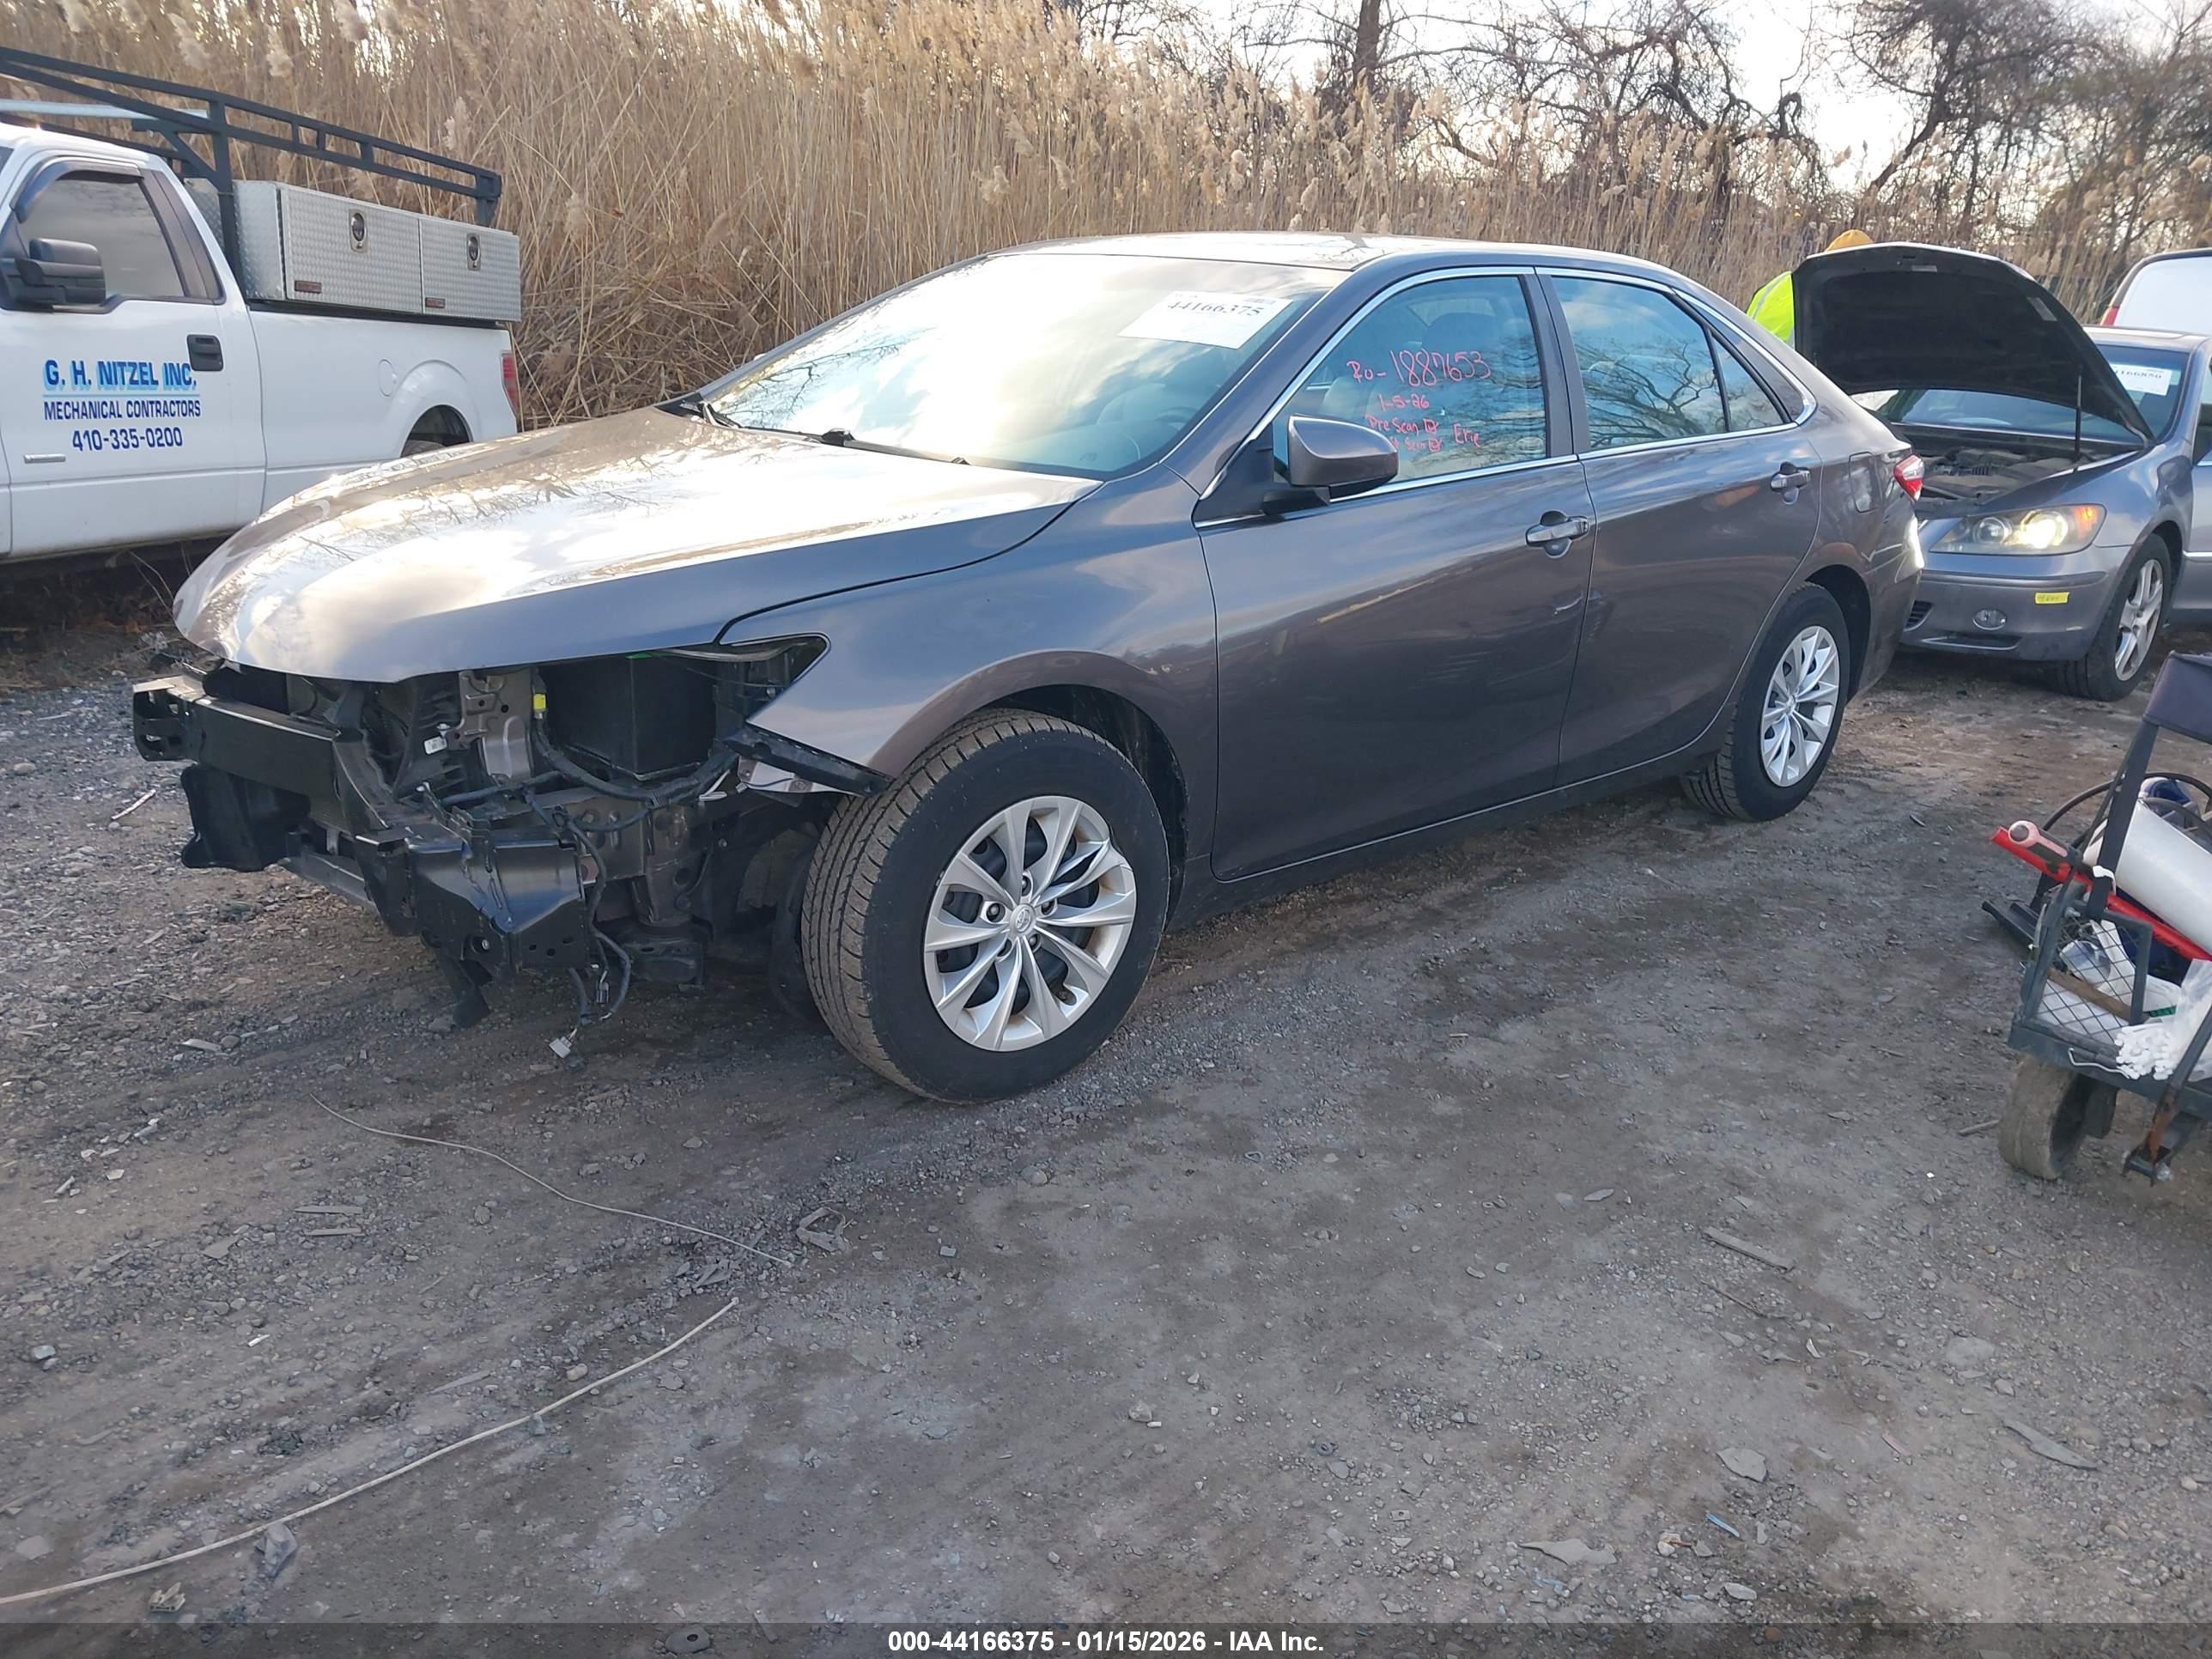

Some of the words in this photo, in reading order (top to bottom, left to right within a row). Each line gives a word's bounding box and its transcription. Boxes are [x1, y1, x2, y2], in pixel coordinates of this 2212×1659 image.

[1168, 301, 1264, 316] 44166375
[45, 360, 65, 386] G.
[71, 361, 92, 386] H.
[96, 361, 159, 387] NITZEL
[163, 362, 197, 387] INC.
[44, 401, 122, 420] MECHANICAL
[126, 399, 201, 417] CONTRACTORS
[72, 427, 183, 451] 410-335-0200
